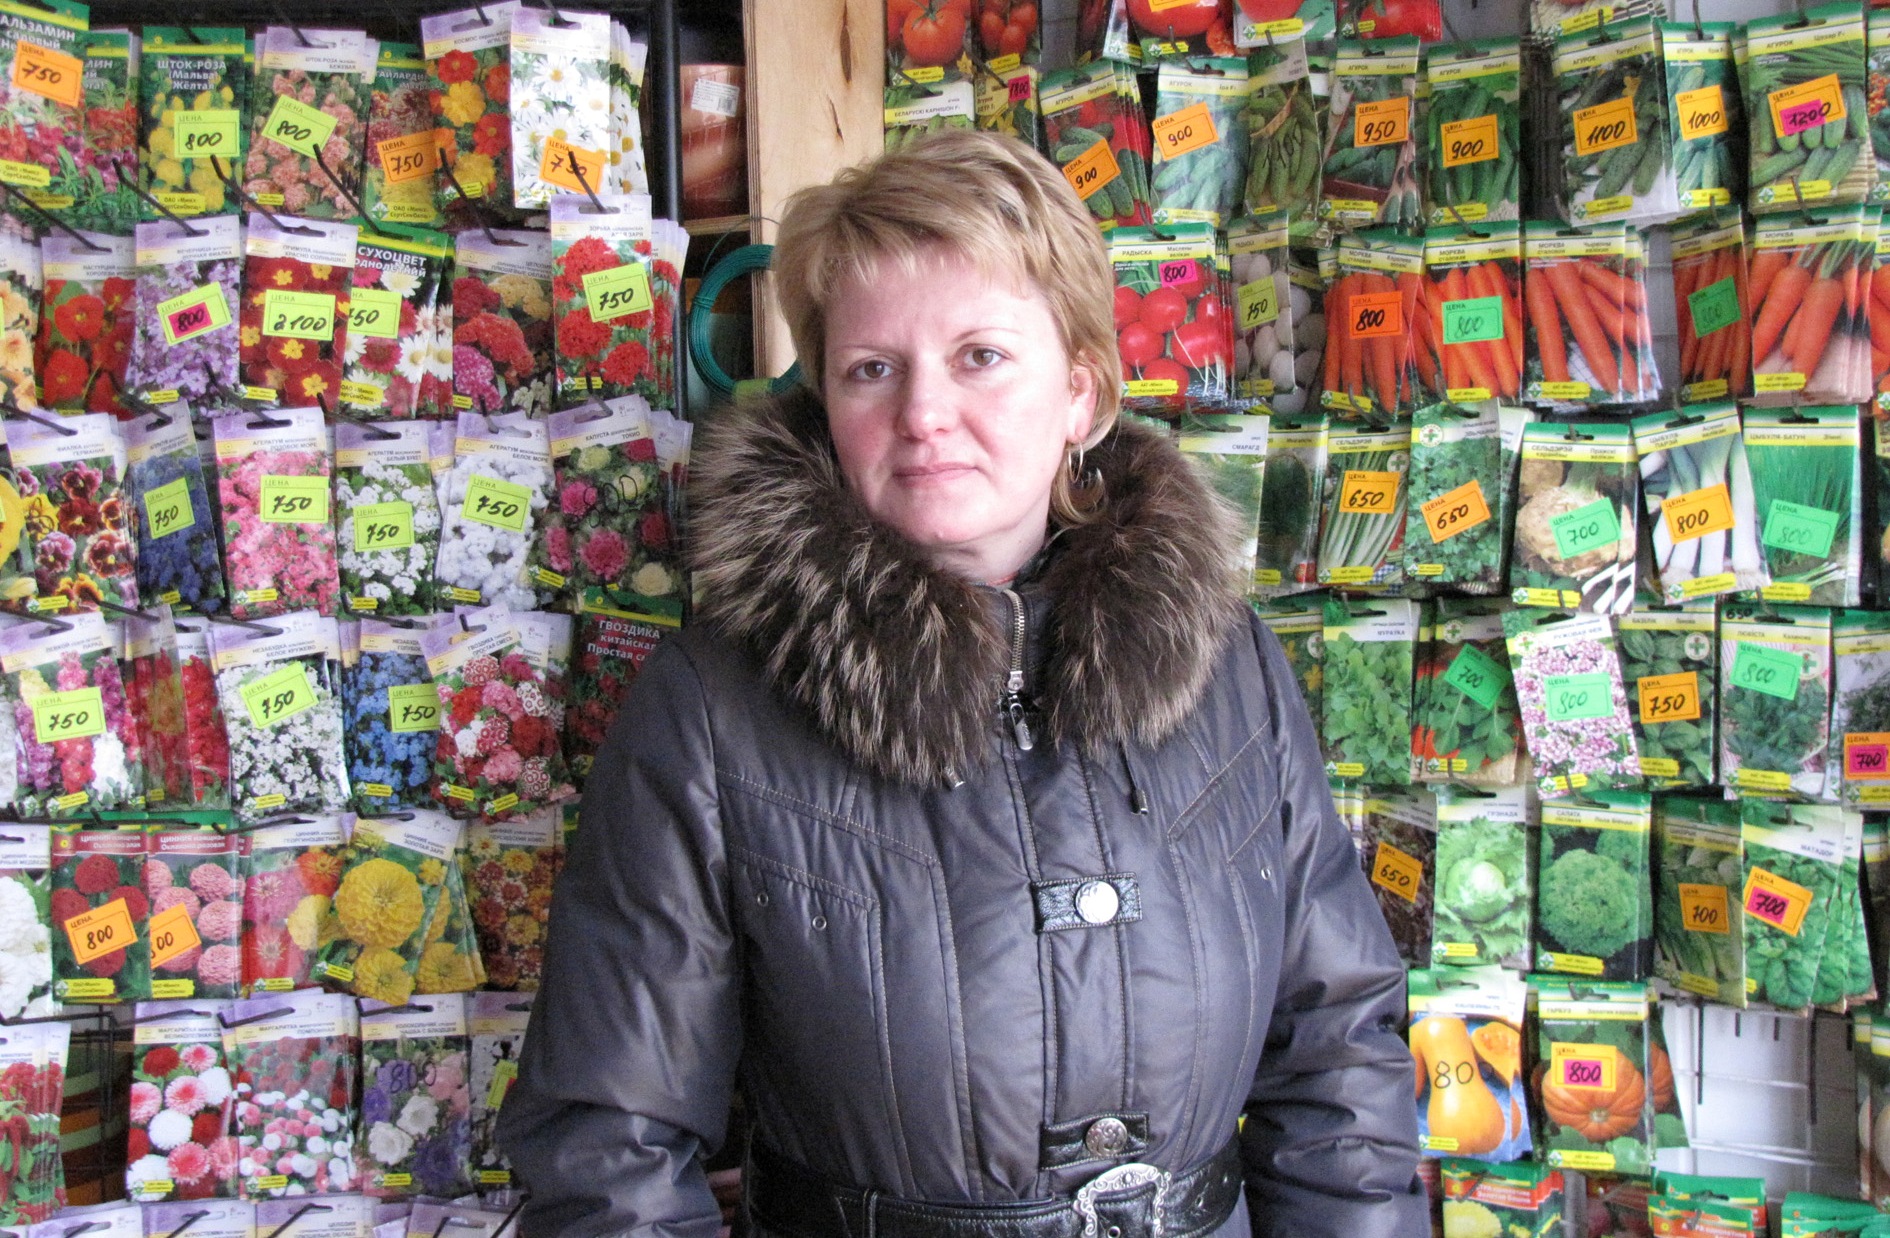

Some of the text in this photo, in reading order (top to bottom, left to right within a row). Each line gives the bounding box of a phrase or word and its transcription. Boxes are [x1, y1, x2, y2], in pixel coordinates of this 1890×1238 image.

[21, 45, 45, 57] ЦЕНА
[1766, 40, 1794, 49] АГУРОК
[157, 60, 227, 71] ШТОК-РОЗА
[1572, 55, 1596, 66] АГУРОК
[21, 62, 62, 84] 750
[1439, 67, 1461, 77] АГУРОК
[1168, 80, 1193, 88] АГУРОК
[1773, 88, 1796, 101] ЦЕНА
[282, 100, 304, 114] ЦЕНА
[1359, 104, 1379, 114] ЦЕНА
[1577, 108, 1597, 120] ЦЕНА
[1788, 102, 1831, 127] 1200
[1155, 116, 1175, 129] ЦЕНА
[1687, 110, 1720, 129] 1000
[276, 120, 311, 141] 800
[1168, 125, 1192, 145] 900
[1363, 120, 1396, 142] 950
[1444, 123, 1463, 133] ЦЕНА
[1587, 121, 1625, 146] 1100
[185, 132, 222, 150] 800
[381, 140, 405, 151] ЦЕНА
[549, 140, 570, 152] ЦЕНА
[1451, 139, 1484, 158] 900
[391, 153, 424, 175] 750
[1065, 158, 1082, 173] ЦЕНА
[1075, 166, 1098, 188] 900
[358, 246, 427, 267] СУХОЦВЕТ
[586, 274, 610, 285] ЦЕНА
[1163, 265, 1187, 283] 800
[160, 299, 185, 312] ЦЕНА
[271, 293, 296, 303] ЦЕНА
[599, 288, 633, 310] 750
[1446, 303, 1466, 311] ЦЕНА
[178, 309, 204, 331] 800
[273, 313, 327, 331] 2100
[1355, 308, 1385, 331] 800
[1455, 314, 1484, 337] 800
[585, 431, 610, 441] КАПУСТА
[622, 431, 641, 439] ТОКИО
[489, 444, 519, 453] АГЕРАТУМ
[1231, 443, 1260, 451] СМАРАГД
[264, 478, 290, 487] ЦЕНА
[473, 478, 497, 489] ЦЕНА
[273, 495, 313, 514] 750
[1349, 488, 1385, 508] 650
[1425, 498, 1446, 511] ЦЕНА
[1665, 496, 1686, 508] ЦЕНА
[356, 508, 379, 517] ЦЕНА
[476, 495, 519, 518] 750
[1776, 502, 1798, 514] ЦЕНА
[155, 506, 179, 527] 750
[1437, 503, 1469, 529] 650
[1552, 514, 1575, 526] ЦЕНА
[1676, 509, 1709, 534] 800
[366, 524, 400, 542] 750
[1567, 522, 1599, 545] 700
[1776, 527, 1812, 546] 800
[599, 620, 661, 639] ГВОЗДИКА
[587, 642, 633, 660] Простая
[1740, 644, 1763, 655] ЦЕНА
[1455, 666, 1484, 689] 700
[1743, 662, 1776, 684] 800
[244, 681, 268, 696] ЦЕНА
[1547, 677, 1570, 686] ЦЕНА
[1641, 679, 1661, 689] ЦЕНА
[36, 695, 62, 706] ЦЕНА
[392, 689, 414, 697] ЦЕНА
[261, 689, 294, 718] 750
[1558, 690, 1588, 714] 800
[1649, 692, 1685, 716] 750
[49, 710, 89, 731] 750
[402, 704, 435, 723] 750
[1846, 734, 1870, 744] ЦЕНА
[1855, 752, 1882, 768] 700
[1380, 863, 1410, 887] 650
[1754, 871, 1775, 885] ЦЕНА
[1755, 893, 1786, 917] 700
[70, 915, 92, 928] ЦЕНА
[86, 925, 113, 950] 800
[1555, 1047, 1576, 1056] ЦЕНА
[1568, 1061, 1602, 1084] 800
